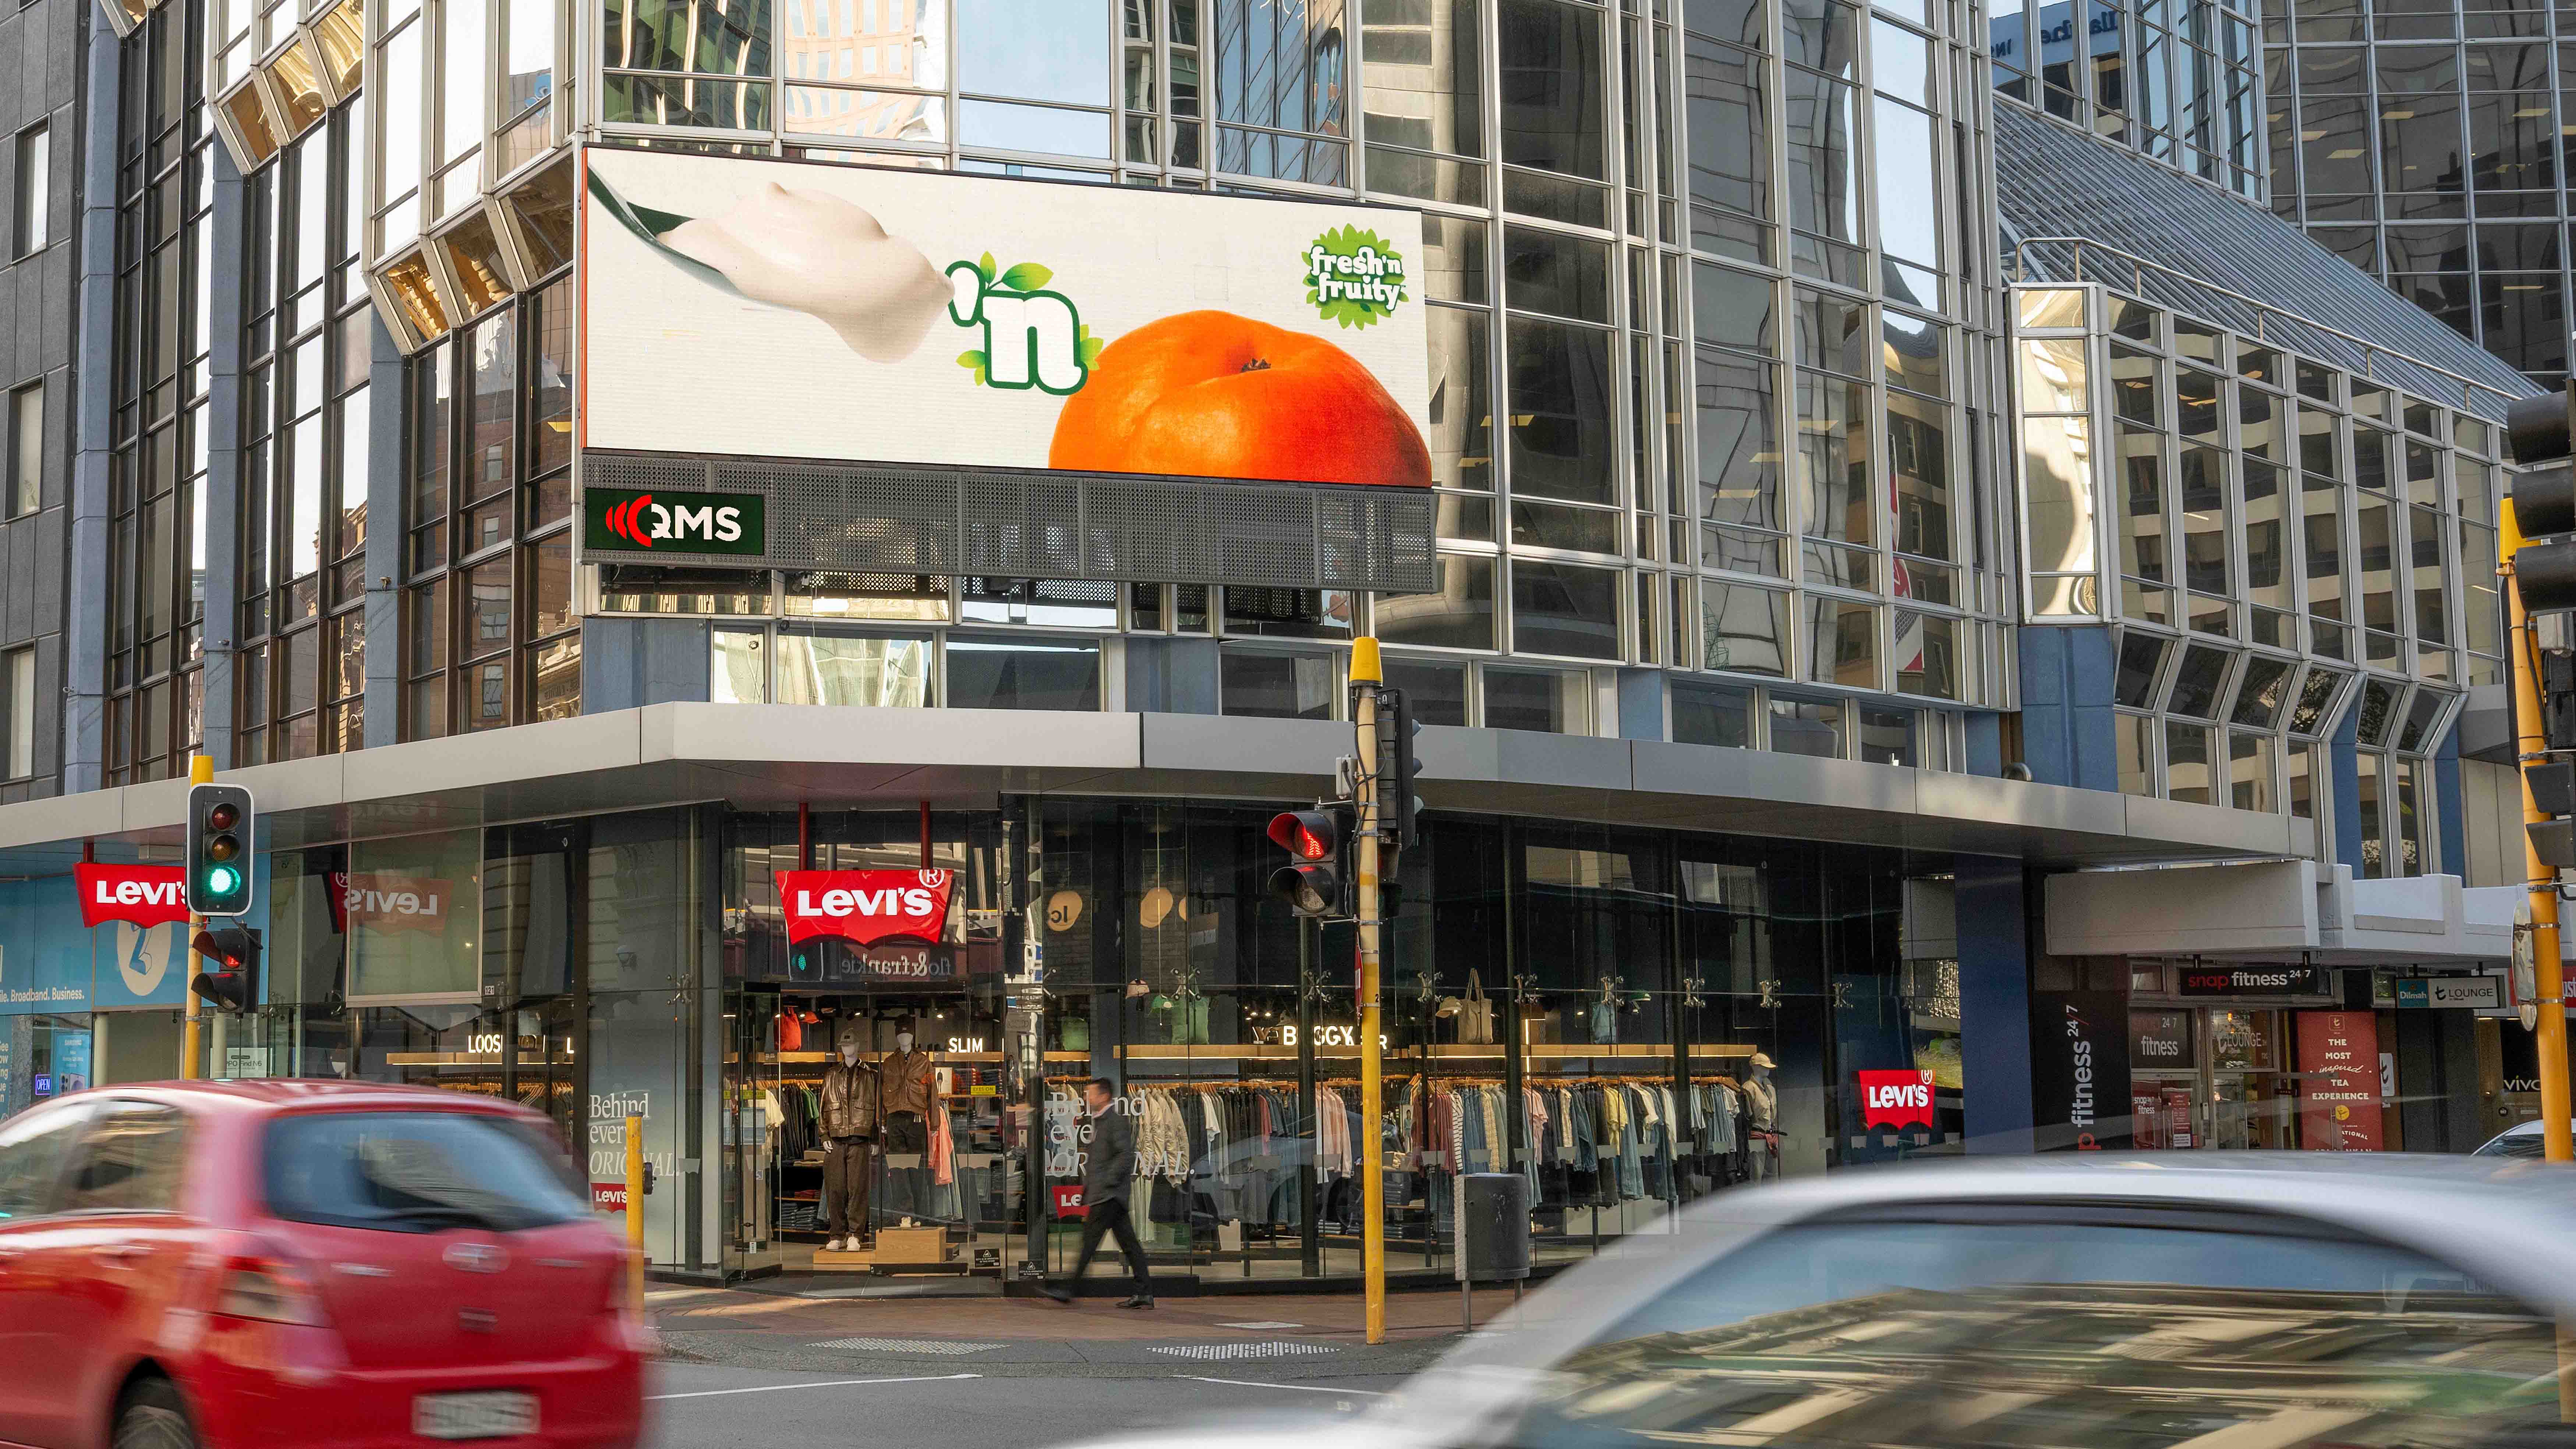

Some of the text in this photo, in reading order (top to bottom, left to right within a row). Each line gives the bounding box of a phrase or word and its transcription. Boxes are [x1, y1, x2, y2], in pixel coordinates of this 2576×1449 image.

[1310, 245, 1403, 276] fresh'n
[1317, 272, 1401, 311] fruity
[627, 495, 742, 547] QMS
[97, 880, 187, 905] Levi'
[2188, 975, 2229, 990] snap
[2232, 972, 2288, 986] fitness
[11, 987, 50, 1002] Broadband.
[52, 986, 85, 1000] Business.
[2399, 991, 2427, 999] Dilmah
[2449, 988, 2494, 998] LOUNGE
[948, 1037, 983, 1053] SLIM
[1283, 1025, 1354, 1046] BGGY
[2227, 1032, 2262, 1047] LOUNGE
[2141, 1035, 2179, 1056] fitness
[2319, 1062, 2364, 1074] inspired
[36, 1079, 50, 1091] OPEN
[2071, 1040, 2094, 1127] fitness
[590, 1093, 650, 1118] Behind
[1050, 1089, 1146, 1116] Bend
[2138, 1105, 2155, 1115] fitness
